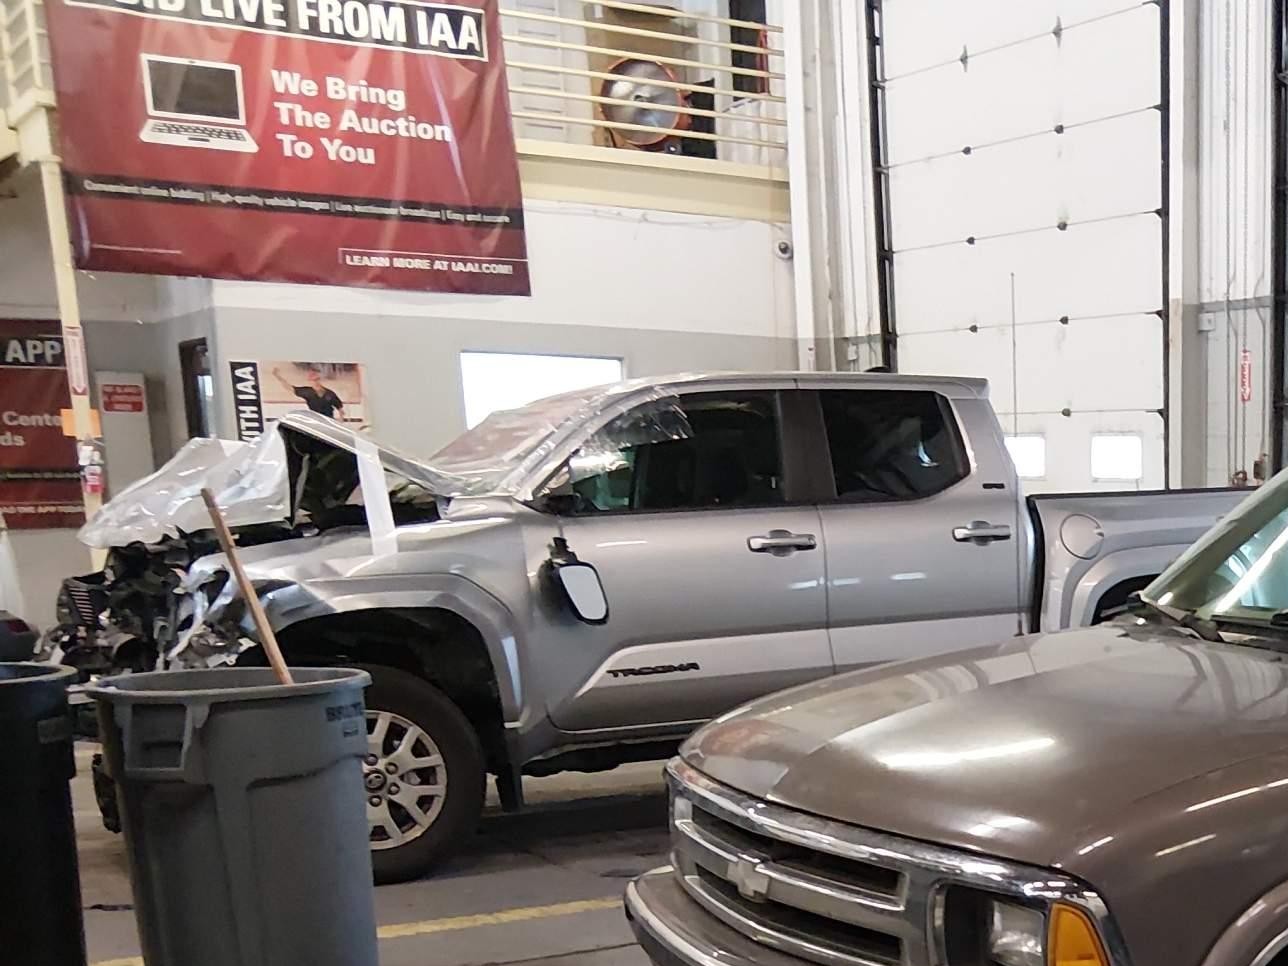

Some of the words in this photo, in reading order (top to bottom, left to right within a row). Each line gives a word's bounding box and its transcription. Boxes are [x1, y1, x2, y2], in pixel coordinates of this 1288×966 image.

[201, 0, 288, 28] LIVE
[298, 0, 408, 44] FROM
[416, 9, 483, 52] IAA
[271, 69, 320, 98] We
[325, 76, 407, 112] Bring
[273, 101, 332, 129] The
[339, 109, 453, 143] Auction
[275, 133, 315, 160] To
[319, 137, 377, 166] You
[345, 254, 391, 268] LEARN
[433, 259, 450, 272] AT
[5, 340, 62, 364] APP
[234, 366, 258, 400] IAA
[2, 410, 62, 427] Cente
[239, 405, 262, 442] ITH
